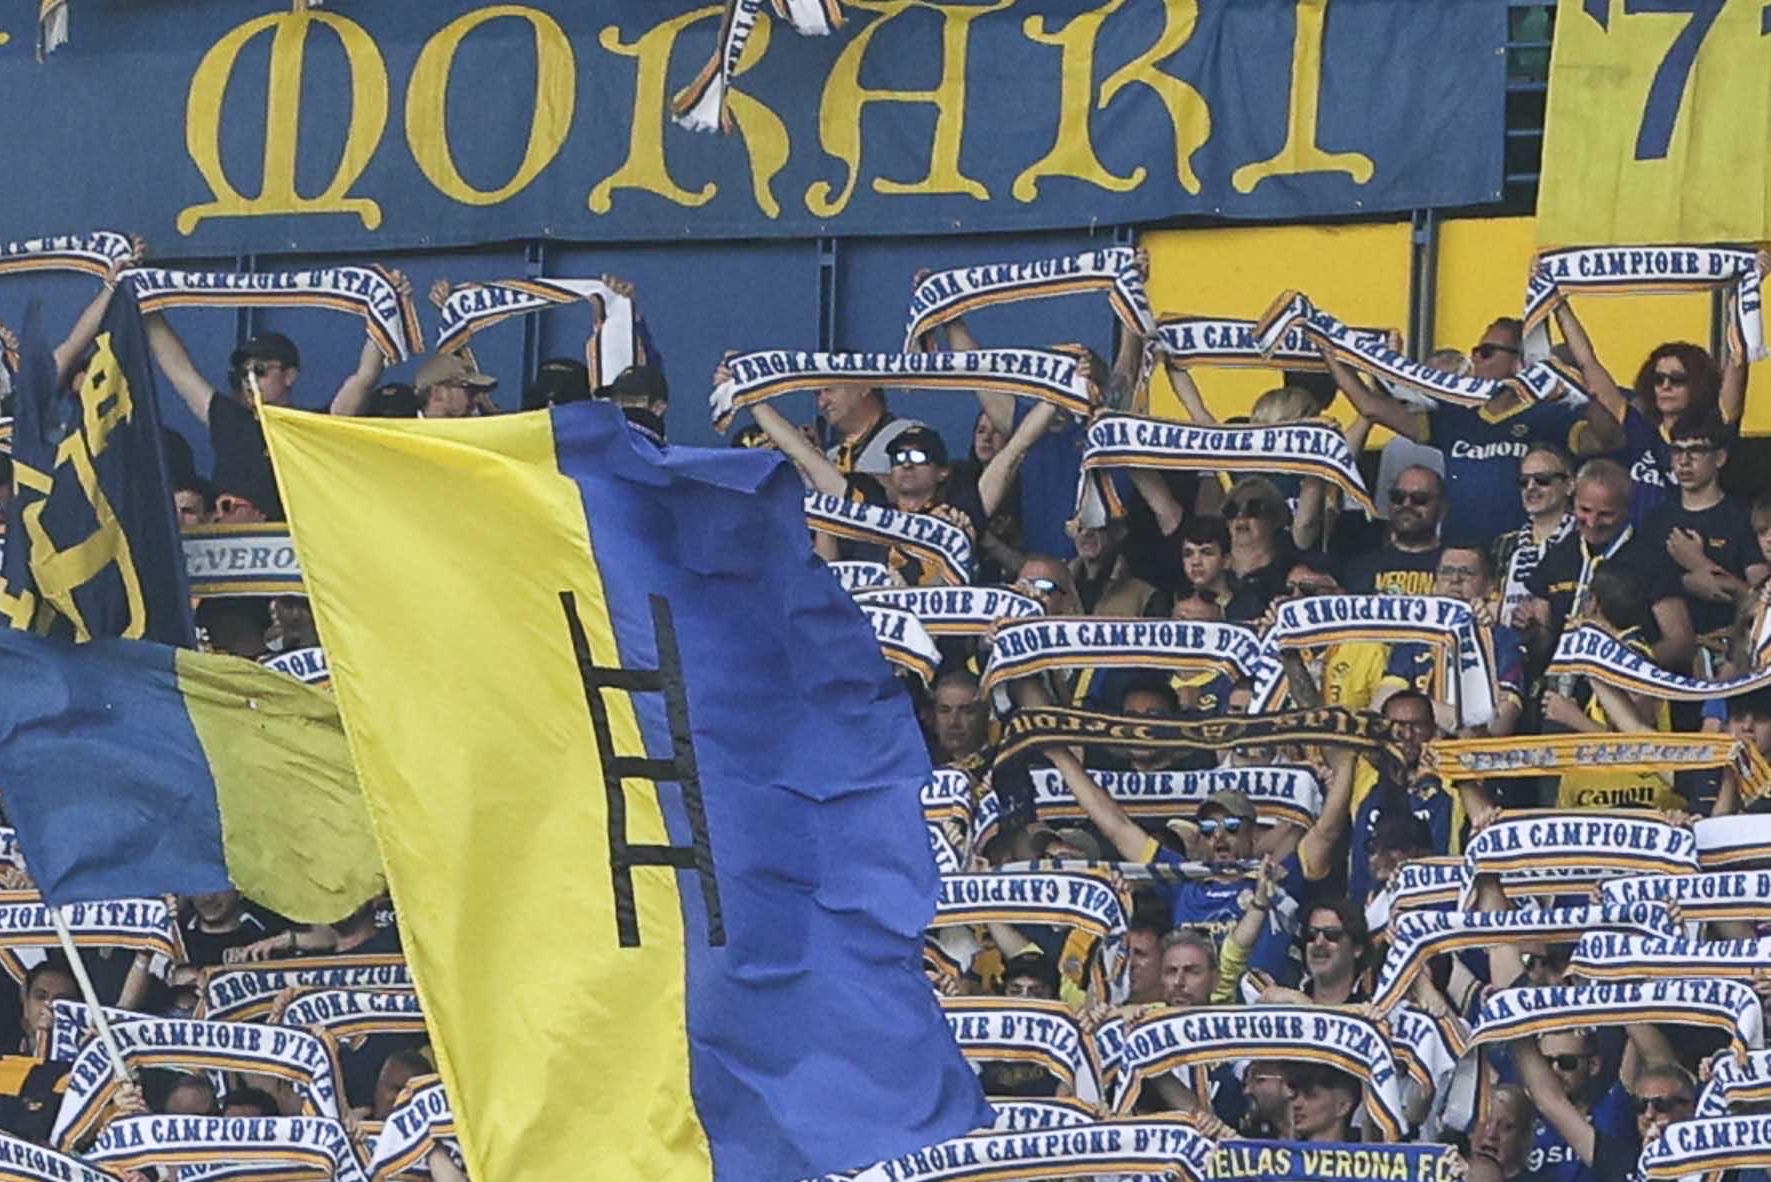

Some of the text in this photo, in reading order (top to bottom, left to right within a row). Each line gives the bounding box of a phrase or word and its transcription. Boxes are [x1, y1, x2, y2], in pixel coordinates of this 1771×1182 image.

[1579, 249, 1698, 275] CAMPIONE
[732, 352, 1074, 387] VERONA CAMPIONE D'ITALIA
[1137, 422, 1355, 466] CAMPIONE D'ITALIA
[1375, 570, 1437, 594] VERON
[998, 620, 1205, 657] ERONA CAMPIONE
[1577, 787, 1654, 807] Canon
[1529, 823, 1657, 848] CAMPIONE
[1621, 875, 1746, 904] CAMPIONE
[1517, 982, 1641, 1012] CAMPIONE
[140, 1023, 263, 1048] CAMPIONE
[1183, 1013, 1303, 1040] CAMPIONE
[153, 1118, 277, 1144] CAMPIONE
[987, 1134, 1122, 1163] CAMPIONE
[1302, 1147, 1408, 1181] VERONA
